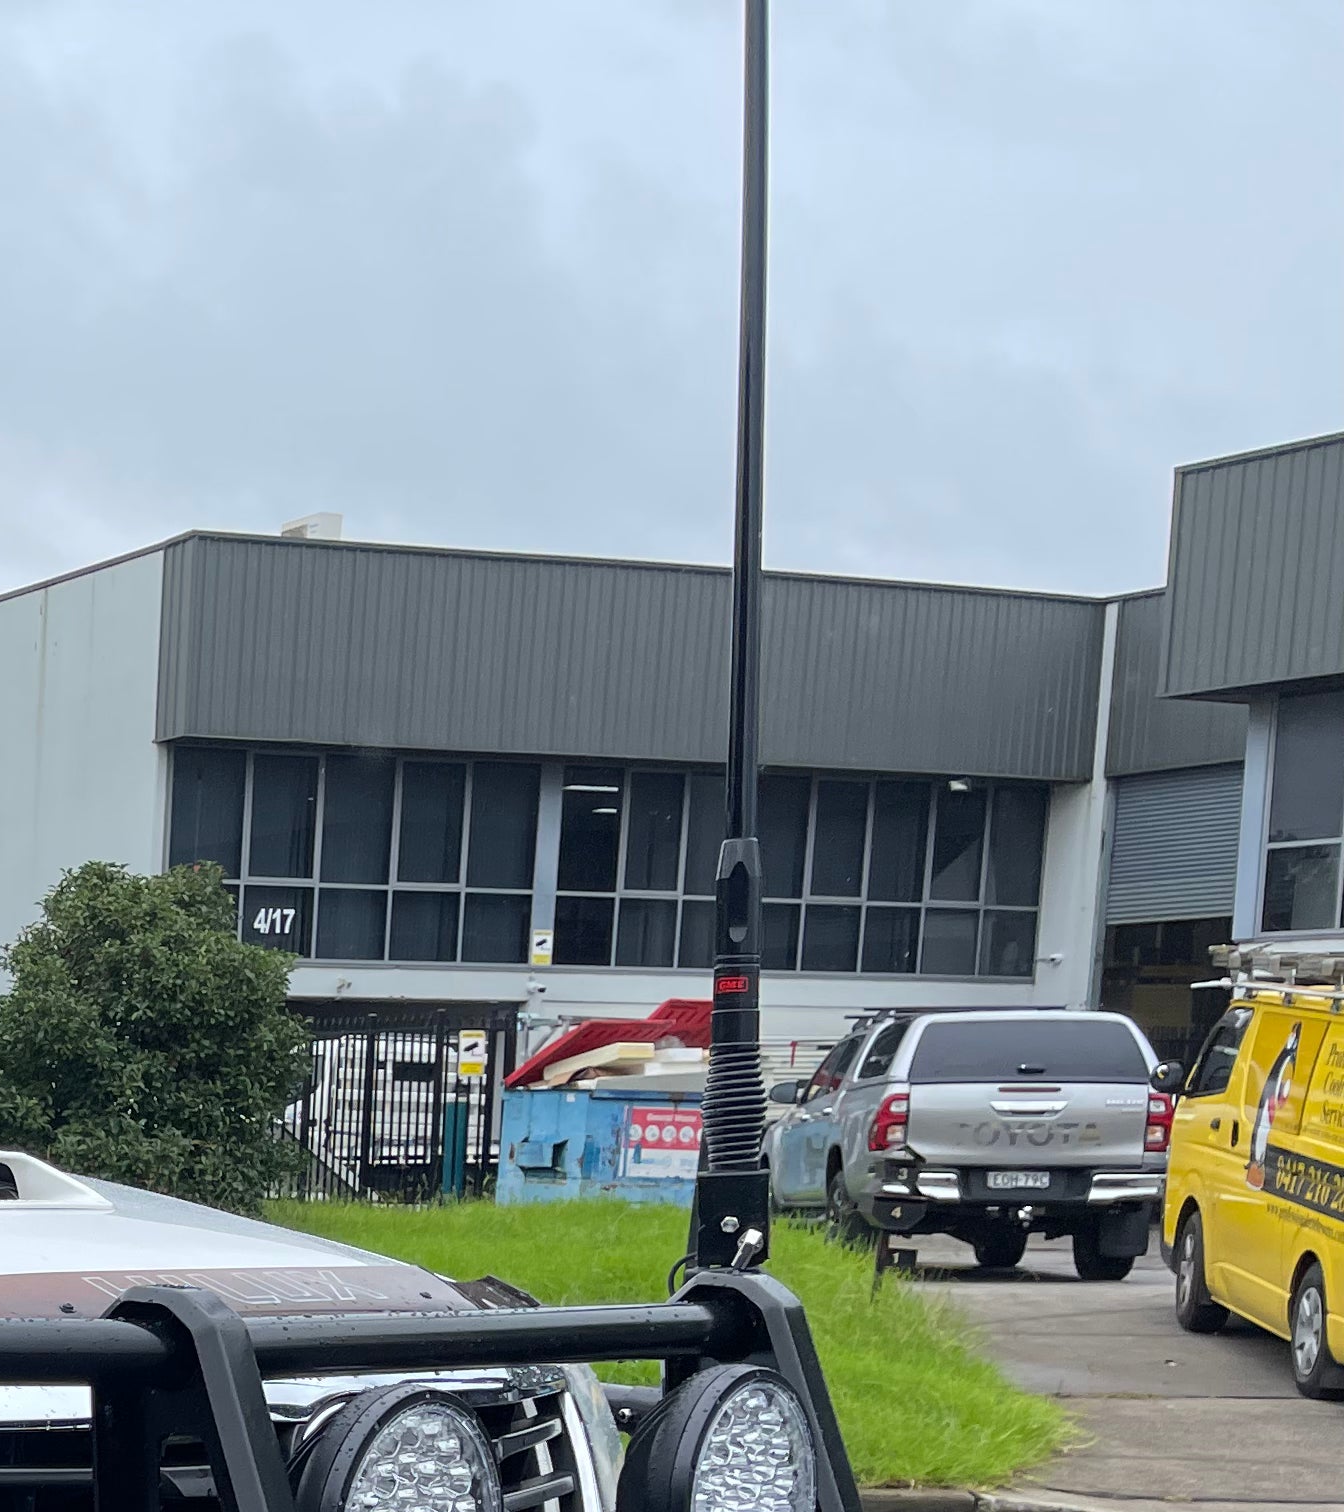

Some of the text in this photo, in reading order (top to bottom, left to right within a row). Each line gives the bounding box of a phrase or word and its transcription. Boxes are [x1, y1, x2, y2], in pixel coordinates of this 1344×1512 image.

[253, 907, 296, 934] 4/17
[897, 1167, 908, 1180] 3
[890, 1206, 902, 1219] 4
